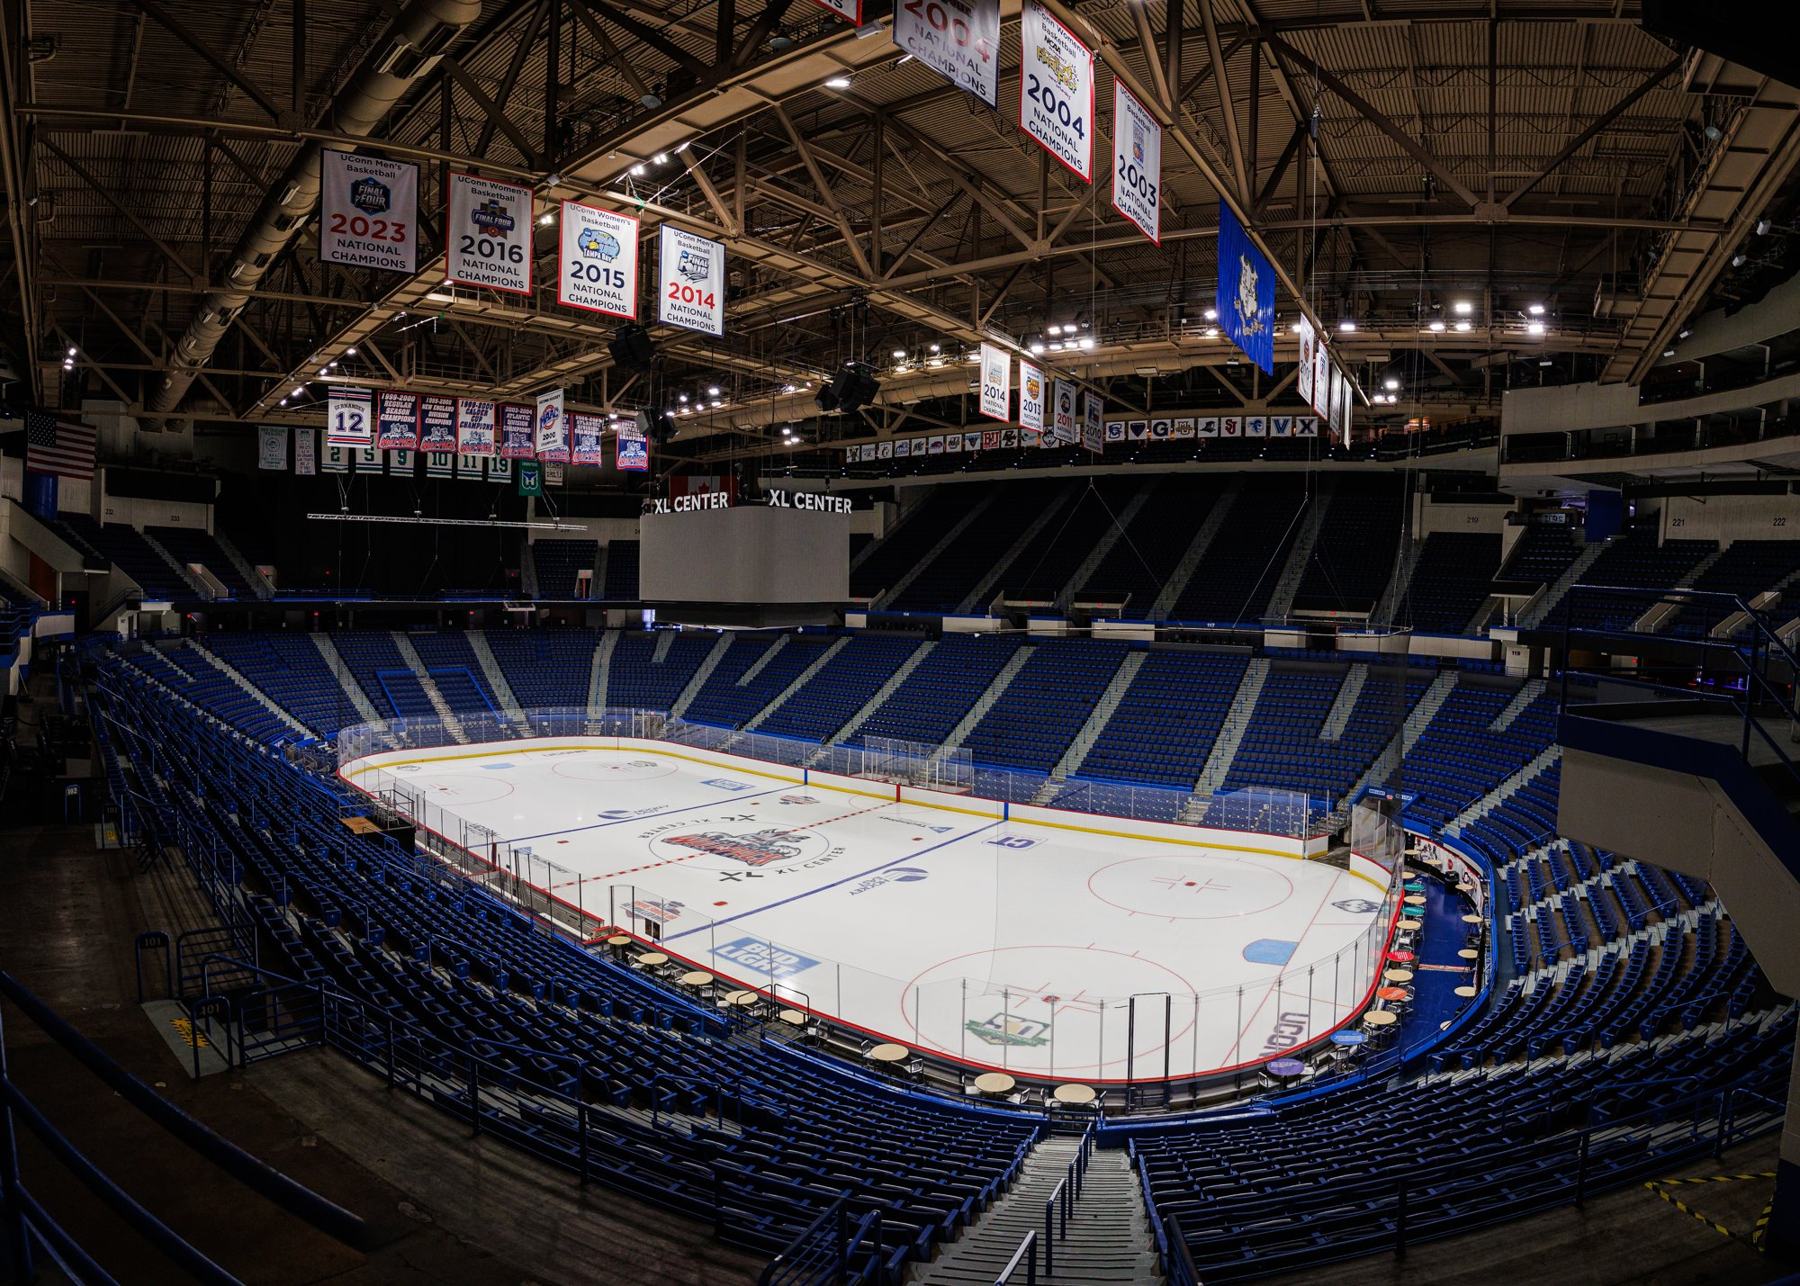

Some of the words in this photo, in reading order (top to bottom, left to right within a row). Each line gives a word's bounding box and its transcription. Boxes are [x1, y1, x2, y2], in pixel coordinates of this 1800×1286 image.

[915, 22, 982, 76] NATIONAL
[1042, 23, 1076, 58] Basketball
[908, 37, 986, 96] CHAMPIONS
[1028, 74, 1085, 140] 2004
[1034, 107, 1078, 152] NATIONAL
[1029, 121, 1082, 170] CHAMPIONS
[341, 155, 372, 165] UConn
[376, 160, 402, 170] Men's
[347, 165, 395, 179] Basketball
[1119, 155, 1156, 207] 2003
[359, 185, 383, 195] FINAL
[458, 176, 487, 187] UConn
[490, 183, 528, 196] Women's
[471, 188, 515, 202] Basketball
[1121, 185, 1152, 220] NATIONAL
[475, 214, 493, 223] FINAL
[494, 218, 512, 227] FOUR
[570, 204, 595, 215] UConn
[598, 211, 630, 225] Women's
[582, 216, 619, 231] Basketball
[1118, 197, 1154, 236] CHAMPIONS
[330, 214, 405, 242] 2023
[337, 239, 400, 255] NATIONAL
[674, 231, 695, 242] UConn
[697, 238, 714, 248] Men's
[678, 240, 710, 255] Basketball
[460, 235, 523, 263] 2016
[332, 251, 406, 269] CHAMPIONS
[463, 258, 520, 276] NATIONAL
[458, 270, 524, 288] CHAMPIONS
[571, 261, 624, 288] 2015
[574, 283, 623, 301] NATIONAL
[669, 282, 715, 310] 2014
[569, 294, 627, 312] CHAMPIONS
[671, 303, 712, 320] NATIONAL
[667, 313, 715, 331] CHAMPIONS
[985, 384, 1005, 402] 2014
[466, 408, 488, 416] CALDER
[1024, 399, 1041, 415] 2013
[336, 412, 363, 432] 12
[380, 414, 416, 423] CHAMPIONS
[460, 421, 493, 430] CHAMPIONS
[1152, 421, 1168, 437] G
[398, 450, 407, 465] 9
[432, 452, 447, 466] 10
[491, 458, 508, 473] 19
[655, 498, 671, 514] XL
[674, 492, 728, 512] CENTER
[769, 489, 789, 507] XL
[794, 492, 852, 514] CENTER
[1672, 518, 1685, 527] 221
[1773, 517, 1786, 527] 222
[803, 847, 846, 868] CENTER
[719, 871, 764, 881] XL
[716, 945, 795, 976] LIGHT
[742, 943, 800, 965] BUD
